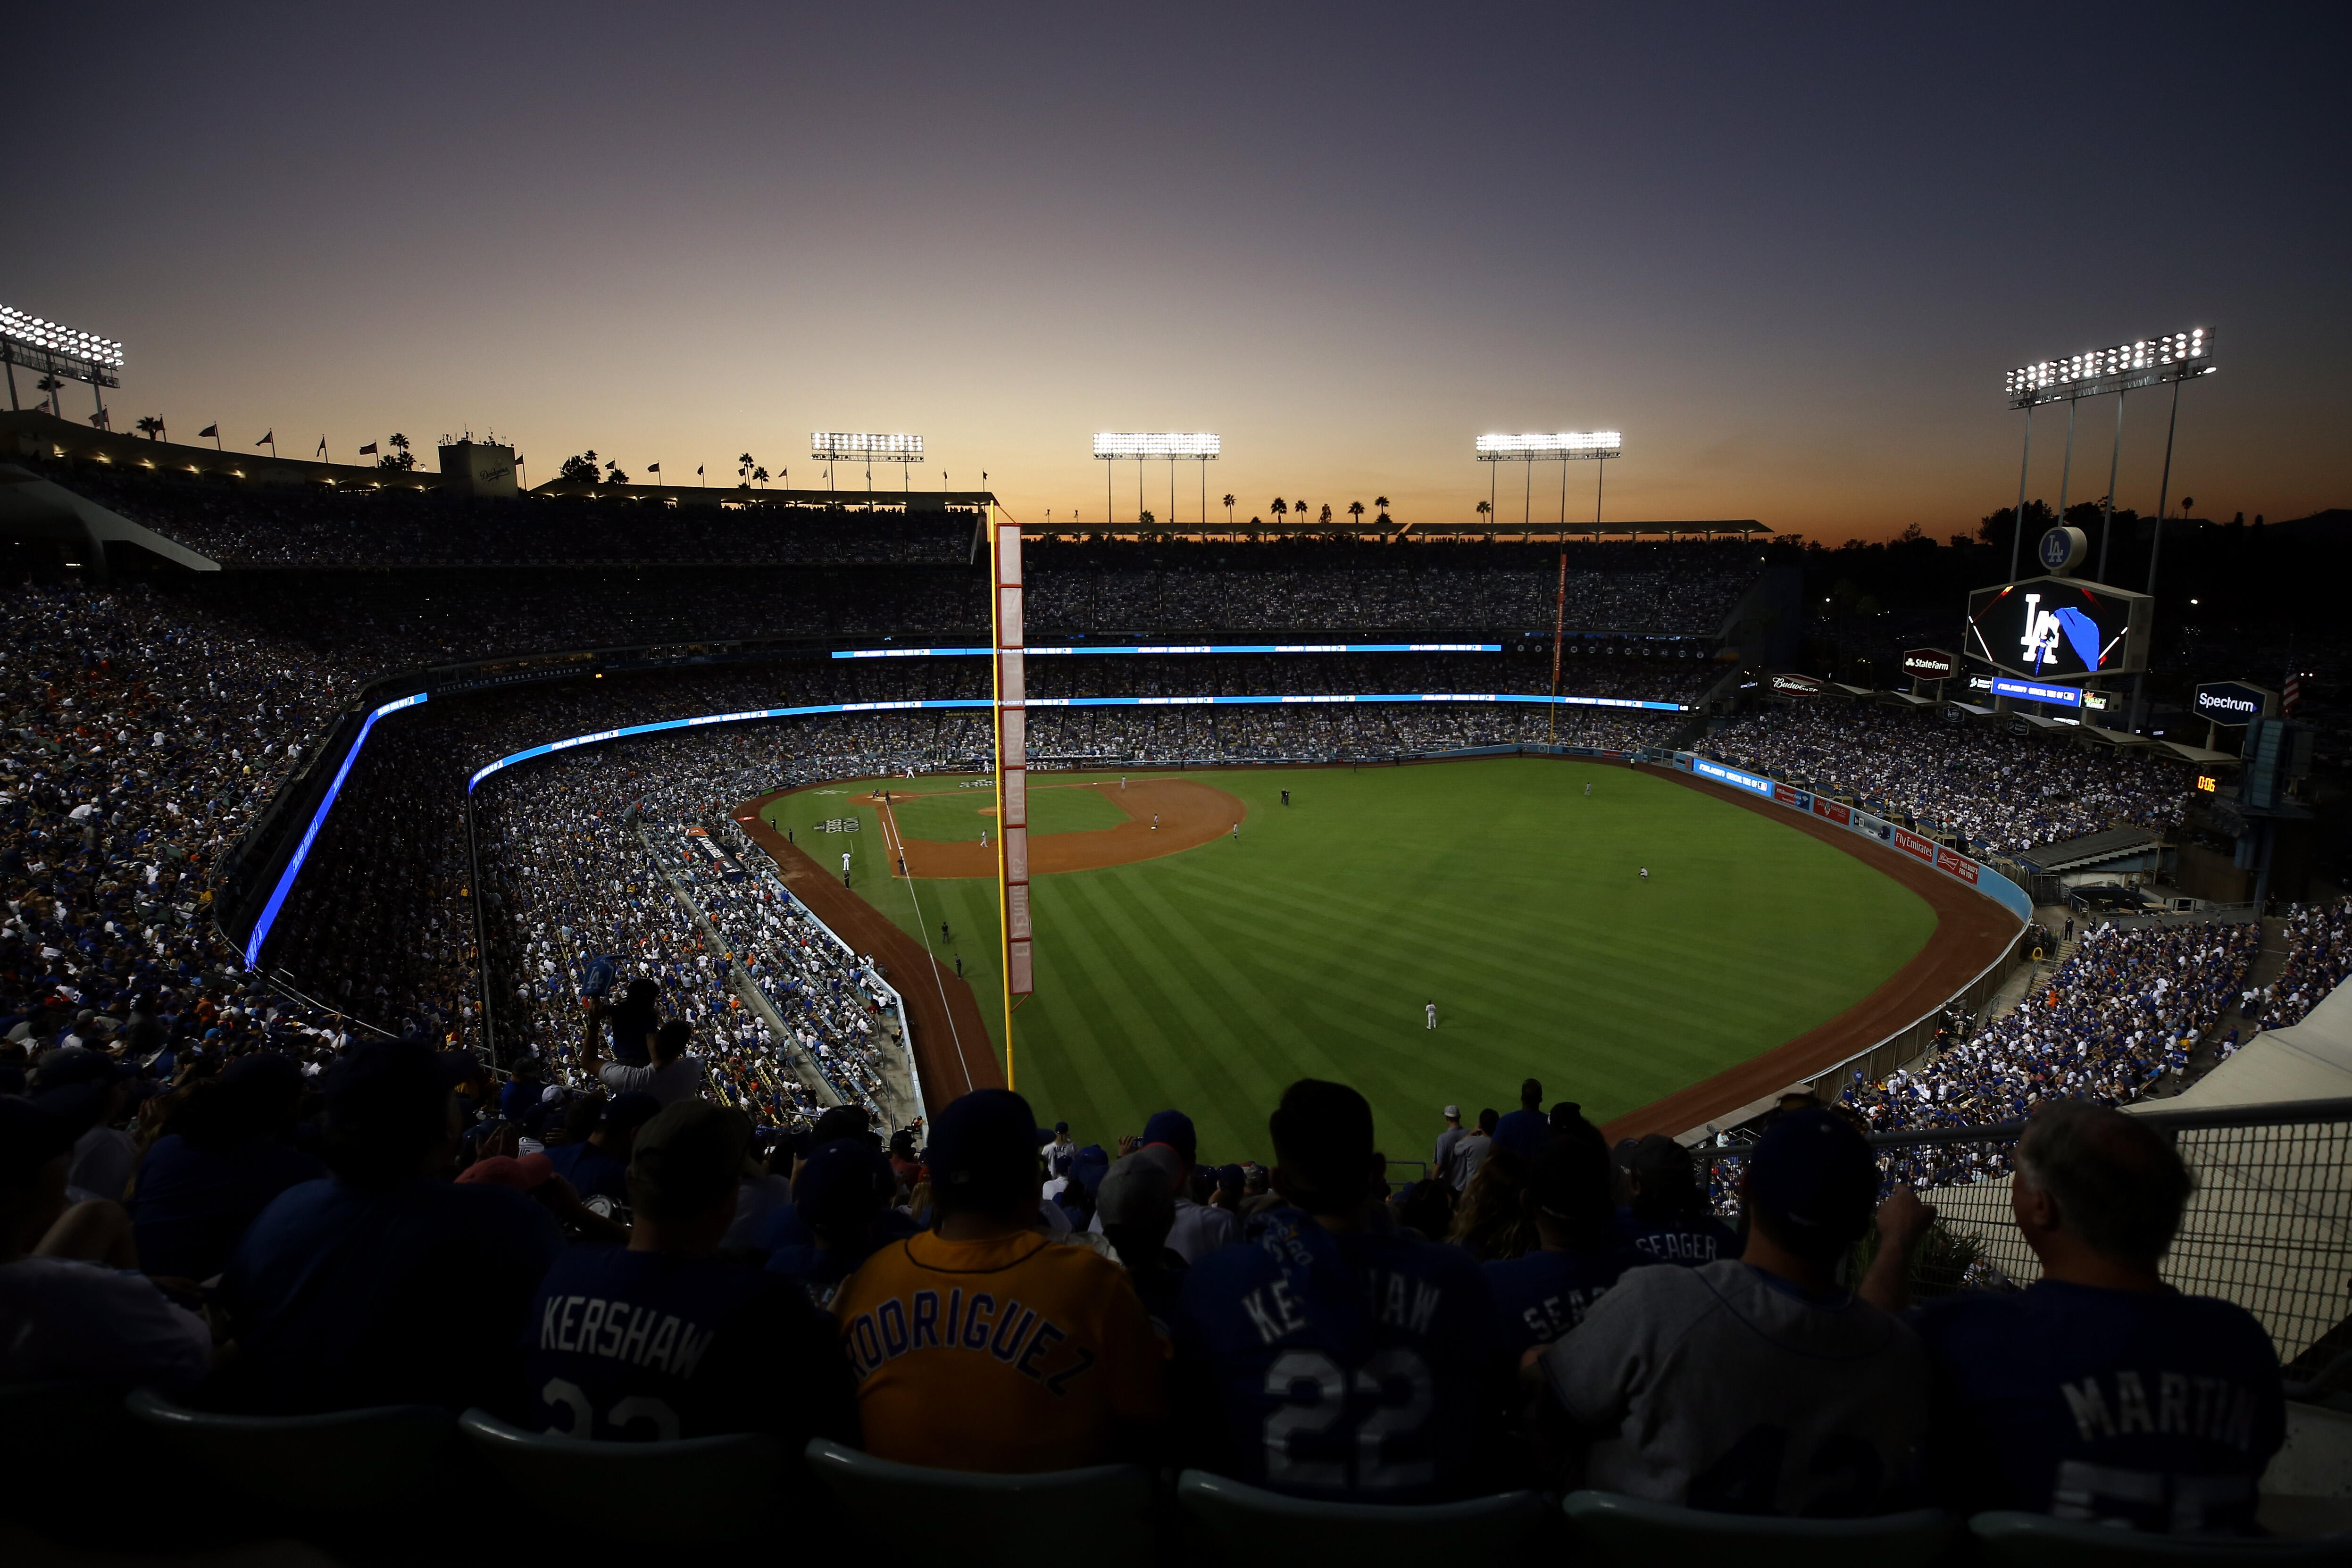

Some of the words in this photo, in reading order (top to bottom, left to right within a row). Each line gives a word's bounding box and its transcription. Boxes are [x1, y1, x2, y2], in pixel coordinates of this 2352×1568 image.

[480, 467, 509, 482] Dodgers
[2047, 535, 2063, 562] LA
[2199, 693, 2254, 712] Spectrum
[2198, 776, 2216, 792] 0:06
[1831, 804, 1846, 816] MANUEL
[1896, 832, 1907, 847] Fly
[1907, 836, 1932, 857] Emirates
[1959, 867, 1967, 877] FOR
[1967, 864, 1978, 875] BUD'S
[1635, 1233, 1717, 1261] SEAGER
[1240, 1266, 1443, 1346] KEAW
[540, 1295, 714, 1380] KERSHAW
[1262, 1347, 1436, 1493] 22
[2060, 1369, 2259, 1451] MARTIN
